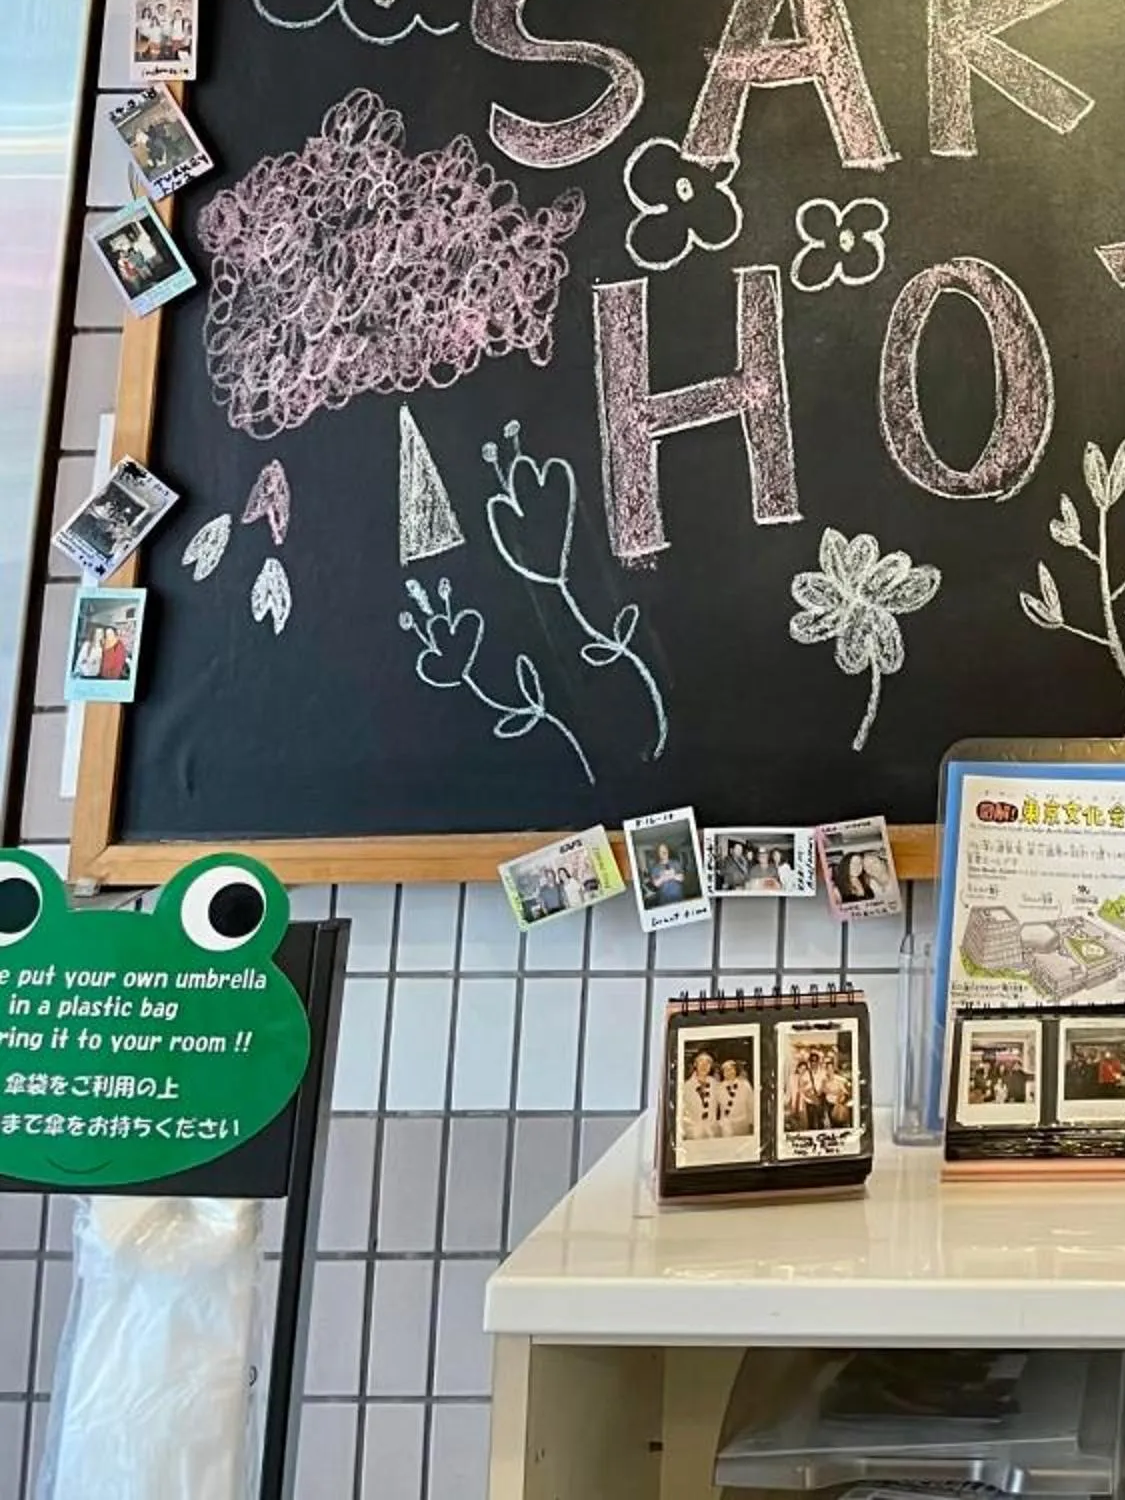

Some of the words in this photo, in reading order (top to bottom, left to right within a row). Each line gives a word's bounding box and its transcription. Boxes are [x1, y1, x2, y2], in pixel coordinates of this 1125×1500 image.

[17, 965, 55, 989] put
[64, 971, 116, 990] your
[123, 971, 169, 988] own
[175, 968, 267, 990] umbrella
[9, 996, 30, 1015] in
[37, 1001, 51, 1016] a
[57, 996, 133, 1019] plastic
[139, 997, 179, 1020] bag
[0, 1027, 43, 1051] ring
[51, 1028, 69, 1049] it
[77, 1028, 102, 1049] to
[111, 1033, 162, 1053] your
[169, 1033, 227, 1052] room
[4, 1072, 180, 1099] 傘袋をご利用の上
